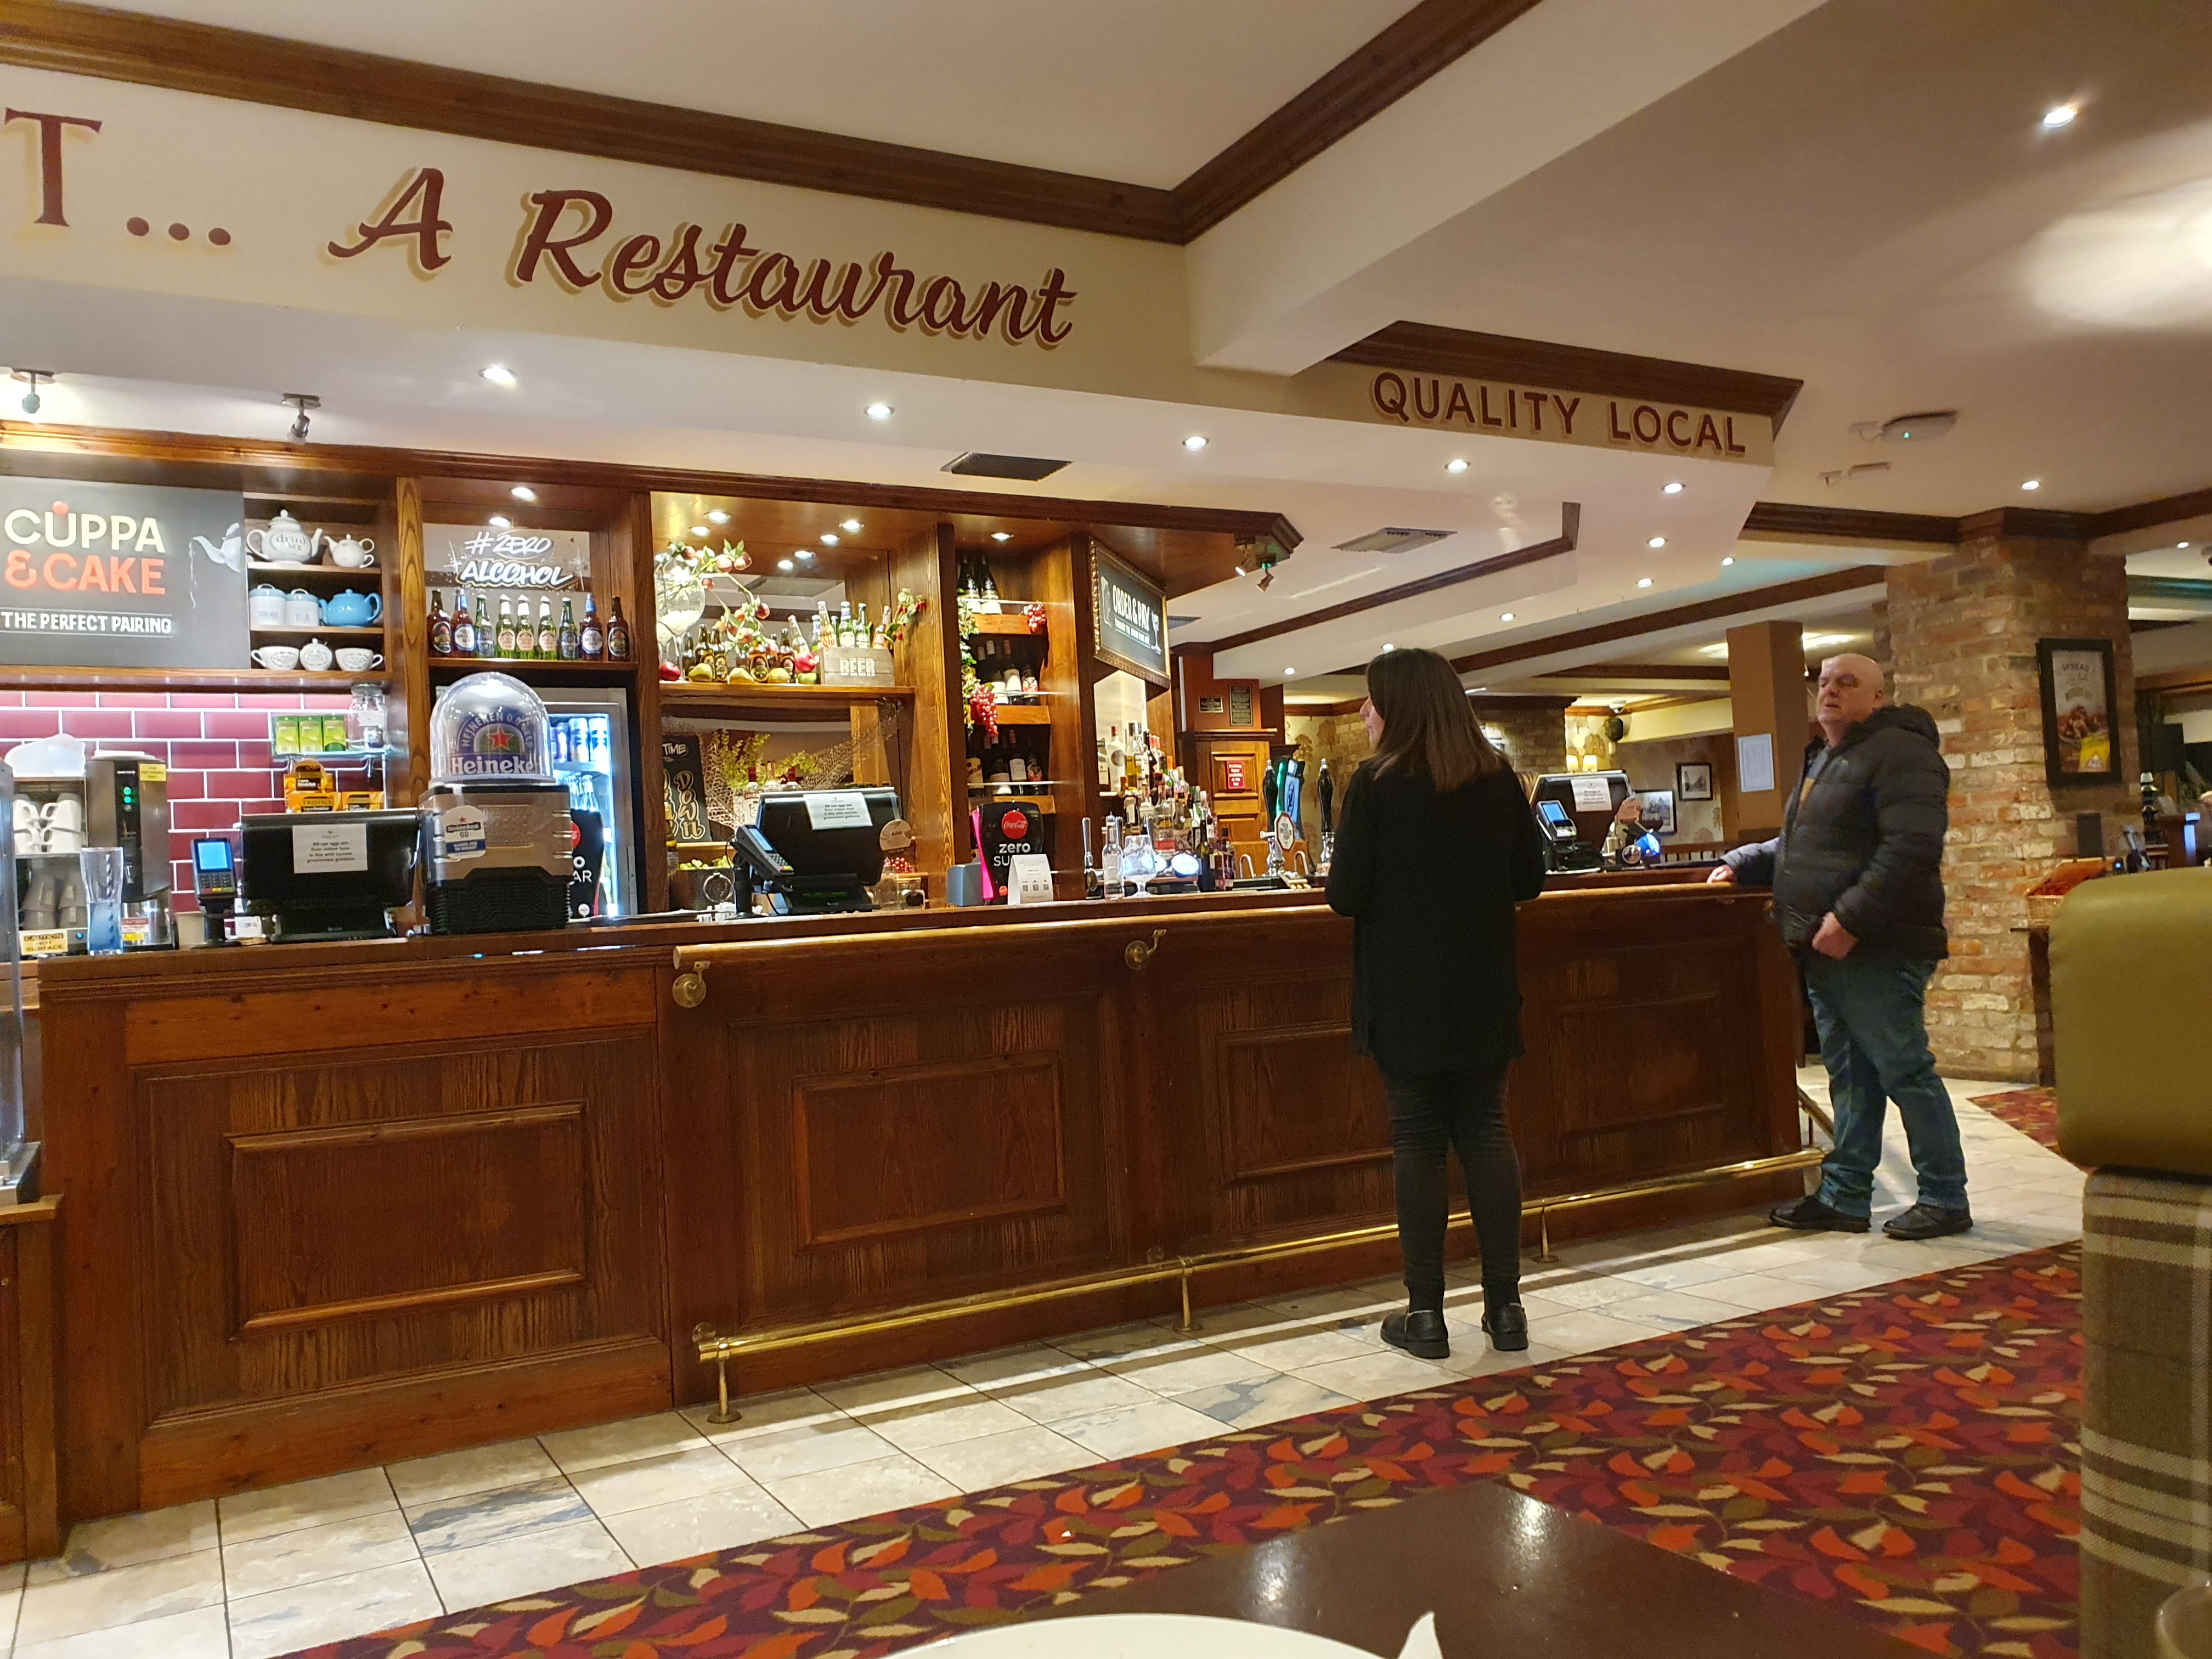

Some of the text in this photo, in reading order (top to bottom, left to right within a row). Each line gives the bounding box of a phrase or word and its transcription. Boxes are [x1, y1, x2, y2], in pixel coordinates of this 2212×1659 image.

[325, 167, 453, 272] A
[513, 189, 1077, 341] Restaurant
[1373, 372, 1746, 453] QUALITY LOCAL
[4, 509, 166, 553] CUPPA
[460, 560, 574, 585] ALCOHOL
[295, 613, 310, 622] TEA
[1113, 584, 1150, 631] ORDER & PAY
[1, 611, 172, 633] THE PERFECT PAIRING
[840, 658, 875, 677] BEER
[662, 743, 687, 755] TIME
[999, 842, 1031, 854] zero
[24, 933, 64, 941] CAUTION
[26, 944, 64, 953] SURFACE
